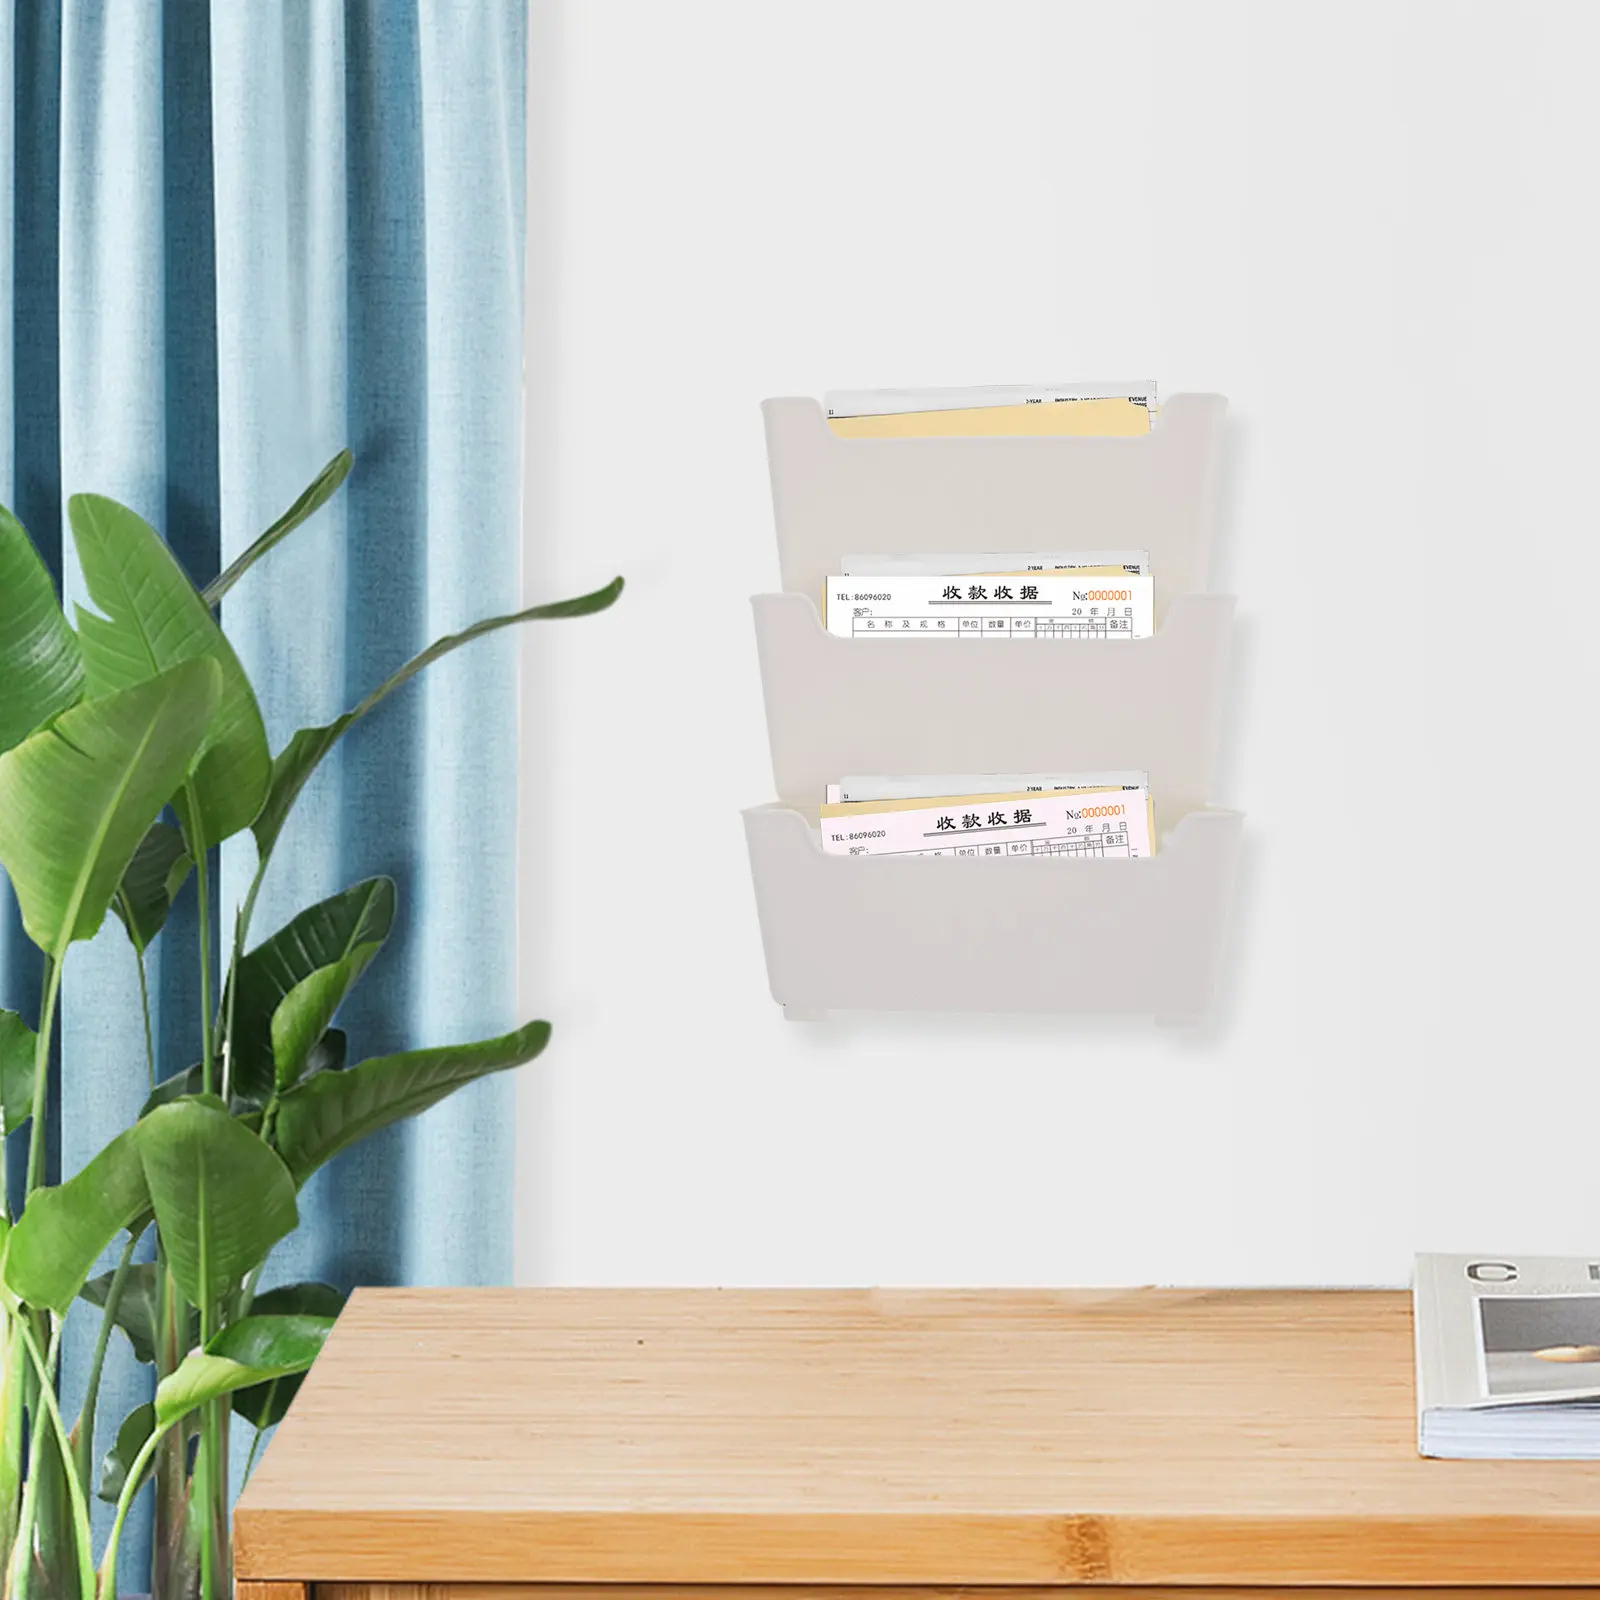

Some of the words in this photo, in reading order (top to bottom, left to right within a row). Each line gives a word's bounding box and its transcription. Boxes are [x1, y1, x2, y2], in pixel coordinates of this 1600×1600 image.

[942, 585, 1039, 600] 收款收据
[1071, 608, 1082, 616] 20
[936, 809, 1033, 831] 收款收据
